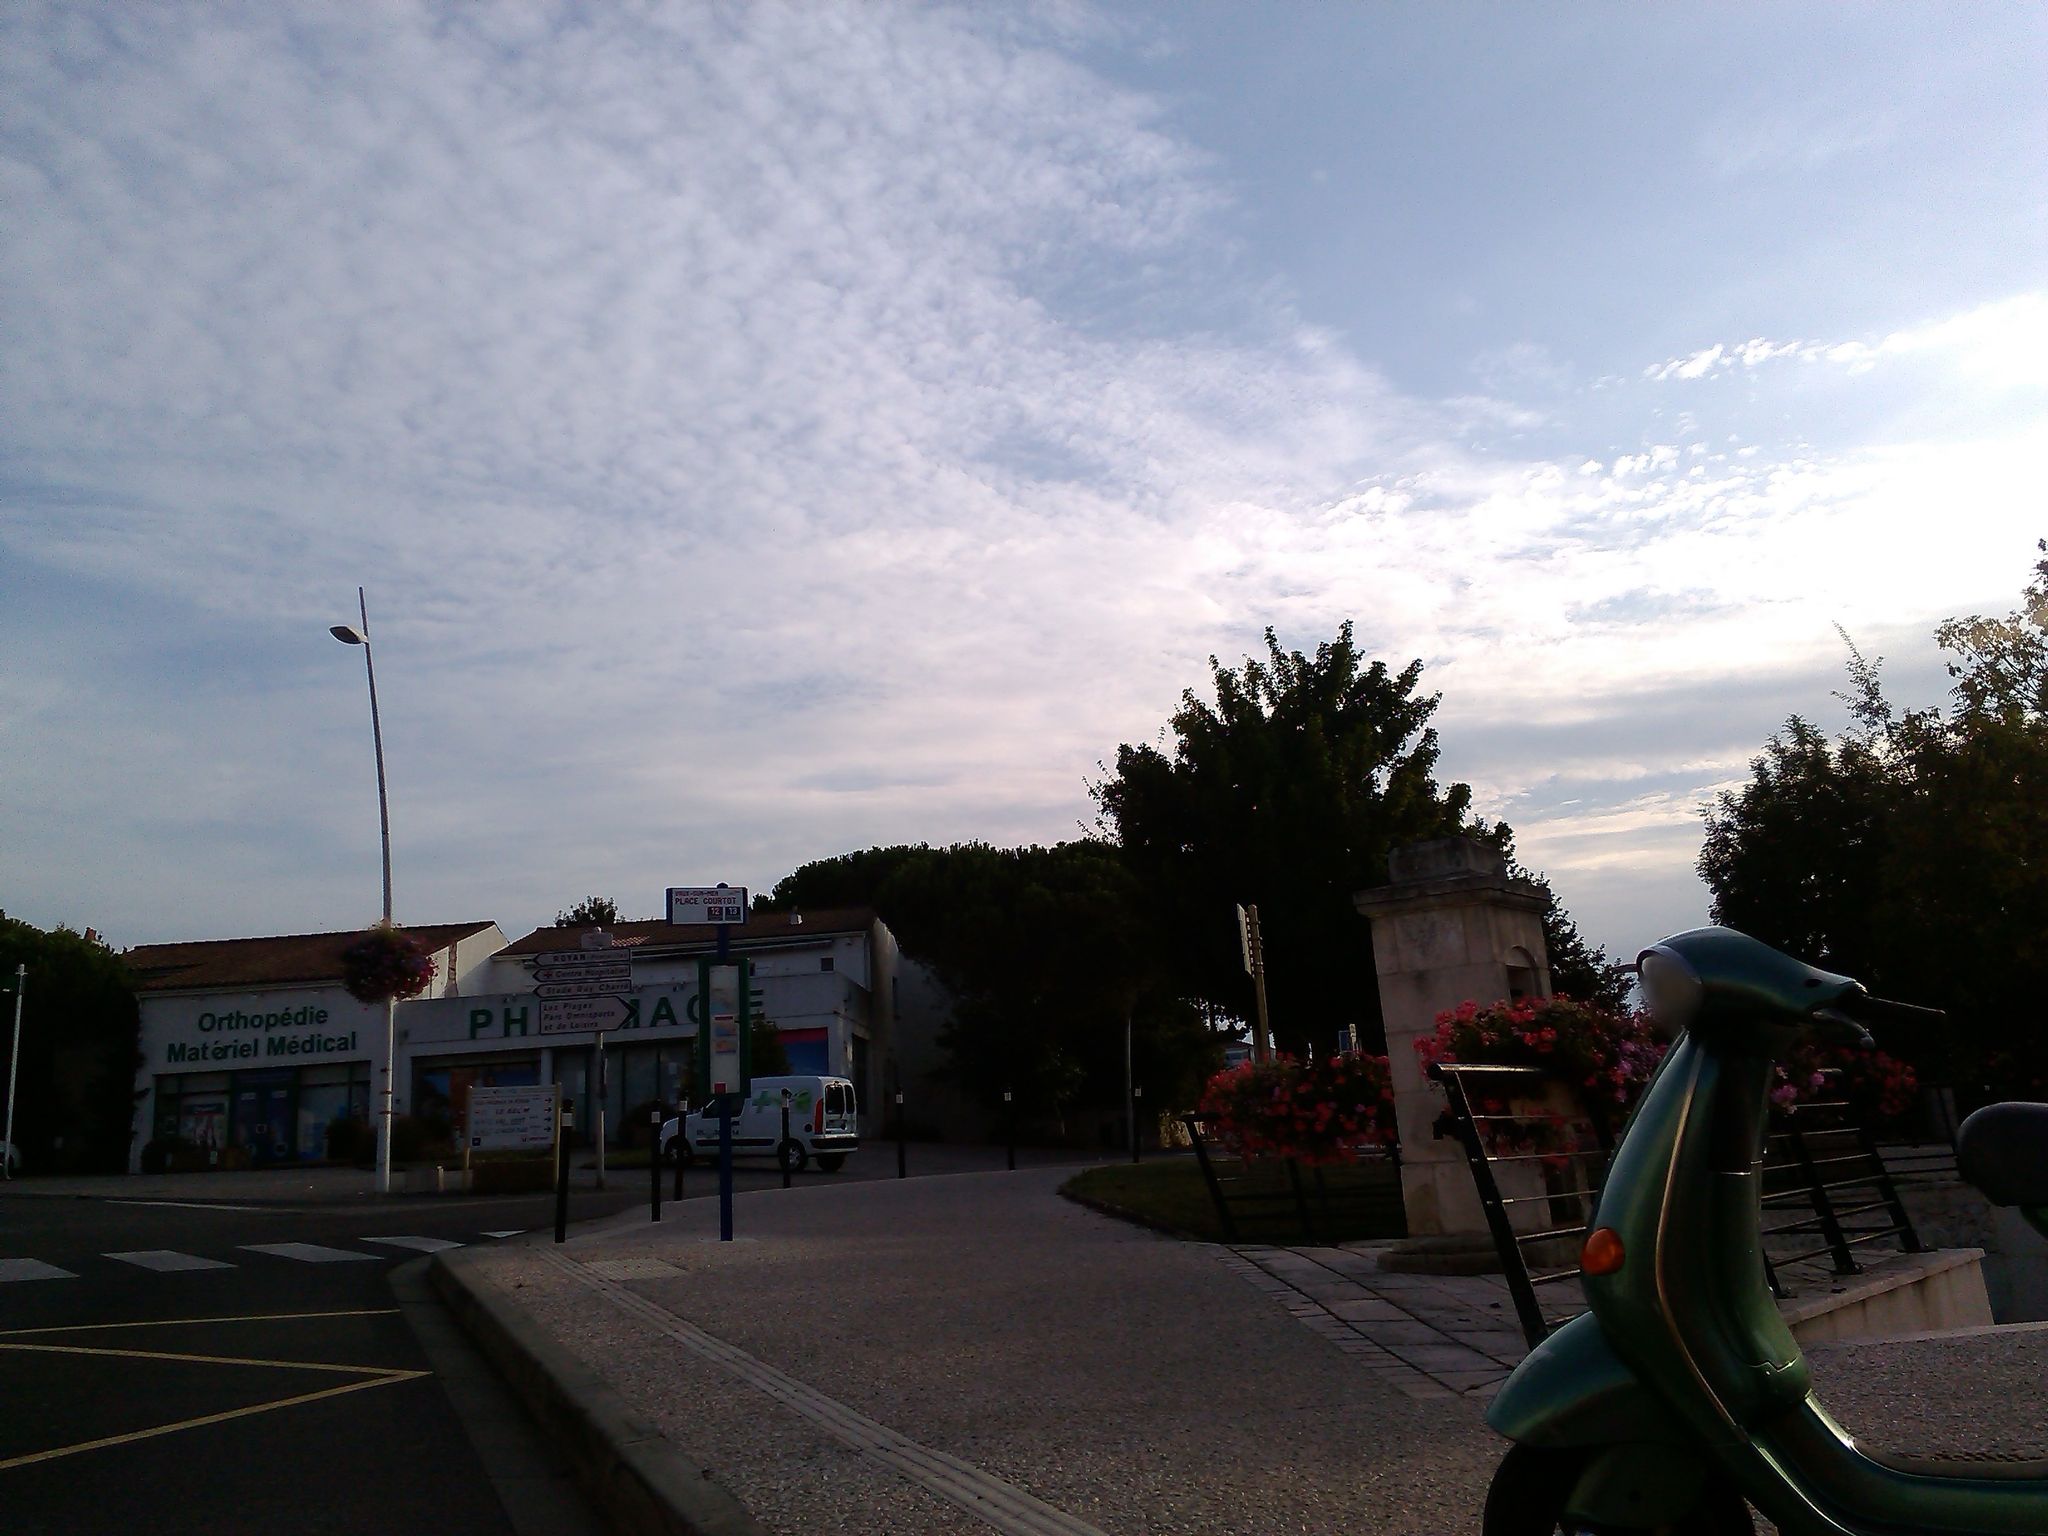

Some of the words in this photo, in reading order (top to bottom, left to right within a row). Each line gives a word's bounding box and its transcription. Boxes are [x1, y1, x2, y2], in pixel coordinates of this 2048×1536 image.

[675, 897, 699, 905] PLACE
[703, 897, 737, 905] COURTOT
[711, 907, 720, 915] 12
[728, 907, 738, 915] 13
[553, 954, 585, 962] ROYAN
[563, 1002, 593, 1011] Plages
[198, 1006, 329, 1033] Orthopédie
[167, 1038, 259, 1063] Matériel
[267, 1031, 357, 1057] Médical
